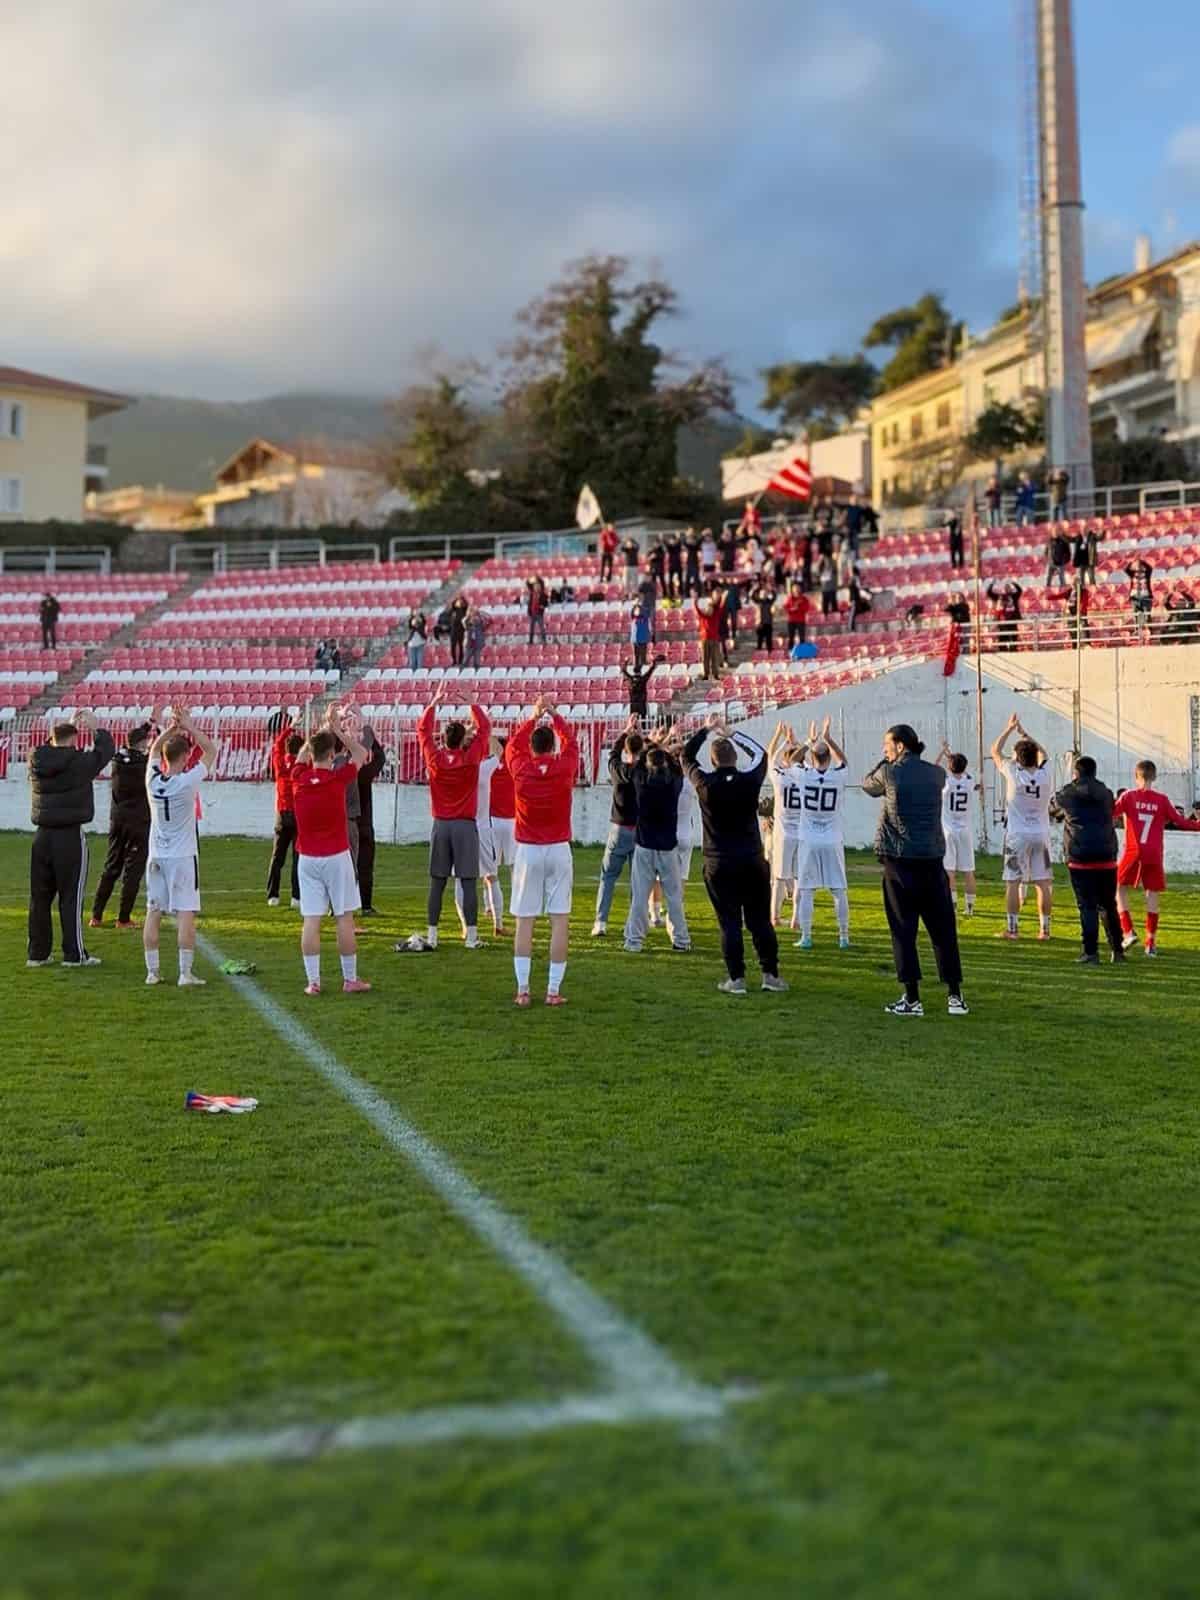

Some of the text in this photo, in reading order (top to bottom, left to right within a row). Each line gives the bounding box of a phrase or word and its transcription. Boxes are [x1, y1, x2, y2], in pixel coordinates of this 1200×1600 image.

[784, 787, 801, 809] 16
[804, 786, 837, 811] 20
[950, 792, 968, 811] 12
[1026, 785, 1040, 798] 4
[154, 796, 169, 820] 7
[1138, 813, 1154, 843] 7
